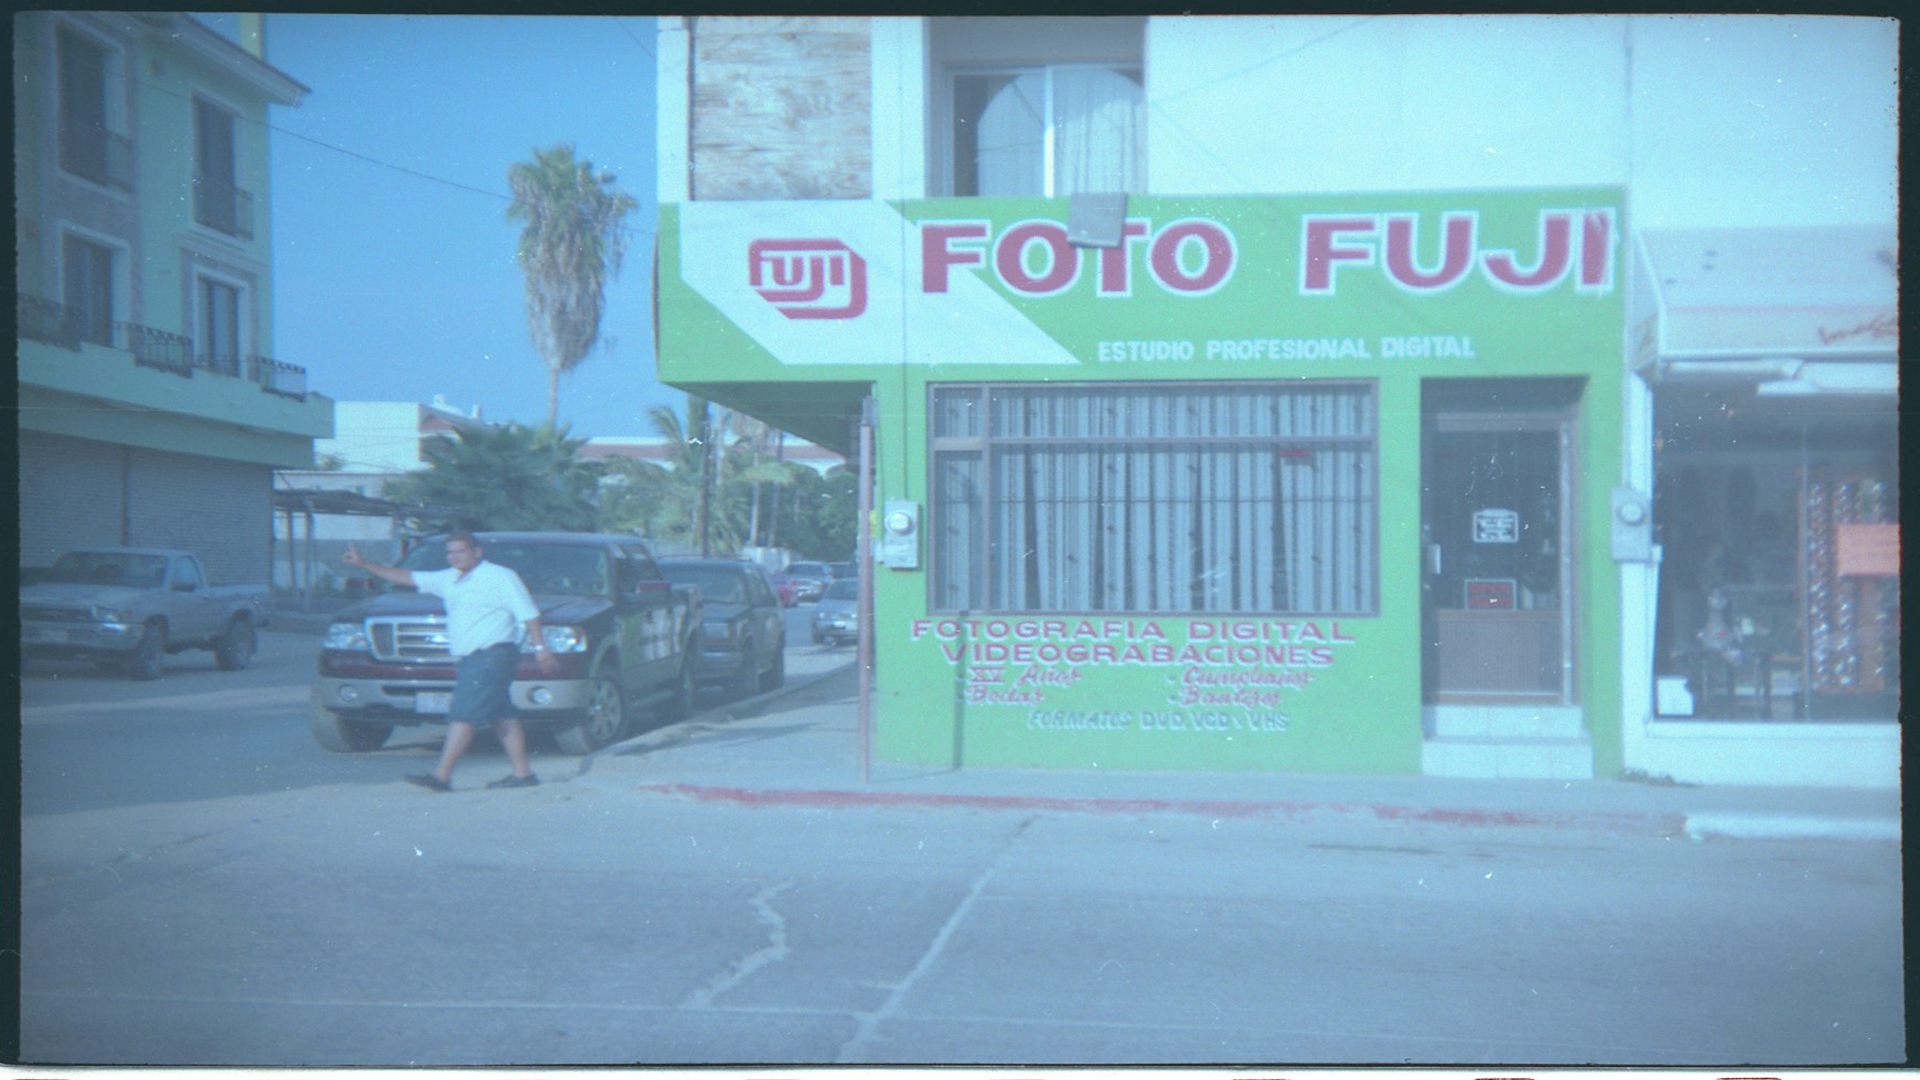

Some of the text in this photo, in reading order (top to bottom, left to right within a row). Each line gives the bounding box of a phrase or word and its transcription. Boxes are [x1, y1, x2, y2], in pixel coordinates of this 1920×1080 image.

[918, 207, 1618, 298] FOTO FUJI
[748, 238, 867, 319] FUJI
[1098, 335, 1475, 362] ESTUDIO PROFESIONAL DIGITAL
[911, 620, 1356, 644] FOTOGRAFIA DIGITAL
[941, 643, 1334, 667] VIDEOGRABACIONES
